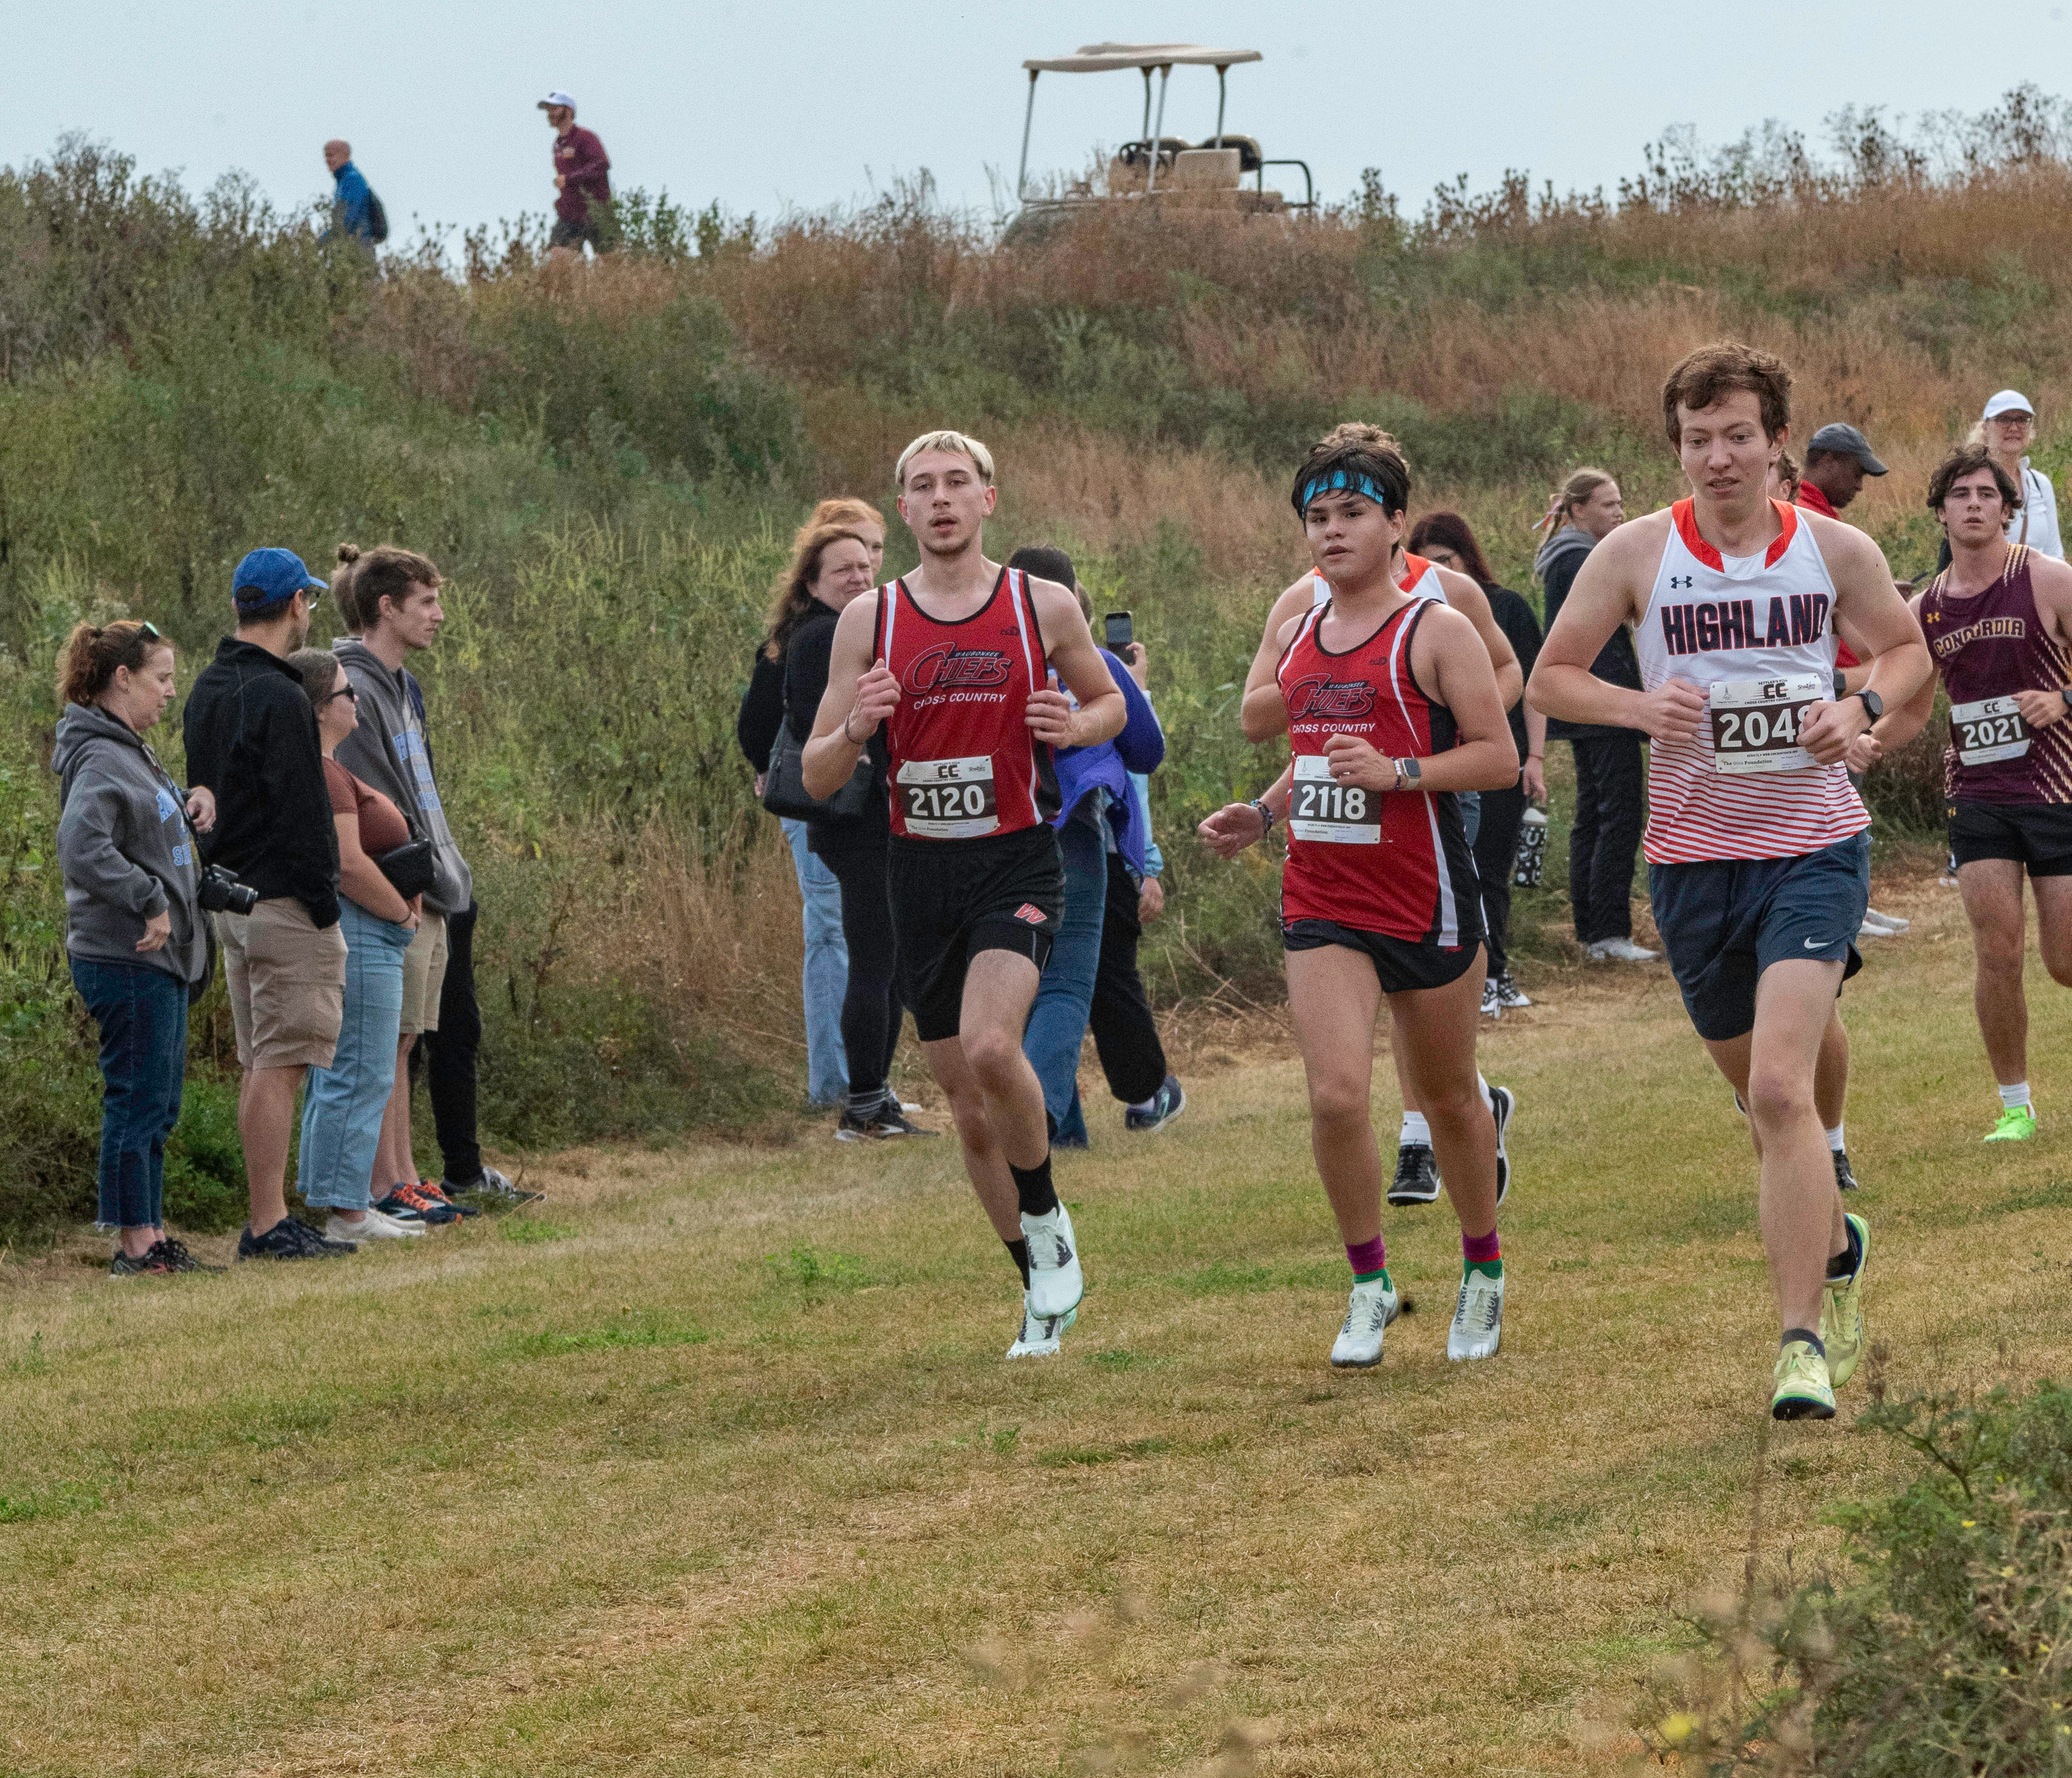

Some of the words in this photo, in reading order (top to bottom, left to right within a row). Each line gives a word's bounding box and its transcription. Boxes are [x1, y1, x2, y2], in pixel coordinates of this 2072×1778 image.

[1660, 593, 1829, 656] HIGHLAND
[902, 641, 1012, 695] CHIEFS
[949, 692, 1007, 703] COUNTRY
[1285, 672, 1376, 719] CHIEFS
[1763, 682, 1787, 699] CC
[1984, 702, 2000, 714] CC
[1321, 722, 1376, 732] COUNTRY
[1962, 715, 2023, 749] 2021
[937, 764, 959, 778] CC
[908, 784, 985, 817] 2120
[1298, 784, 1366, 820] 2118
